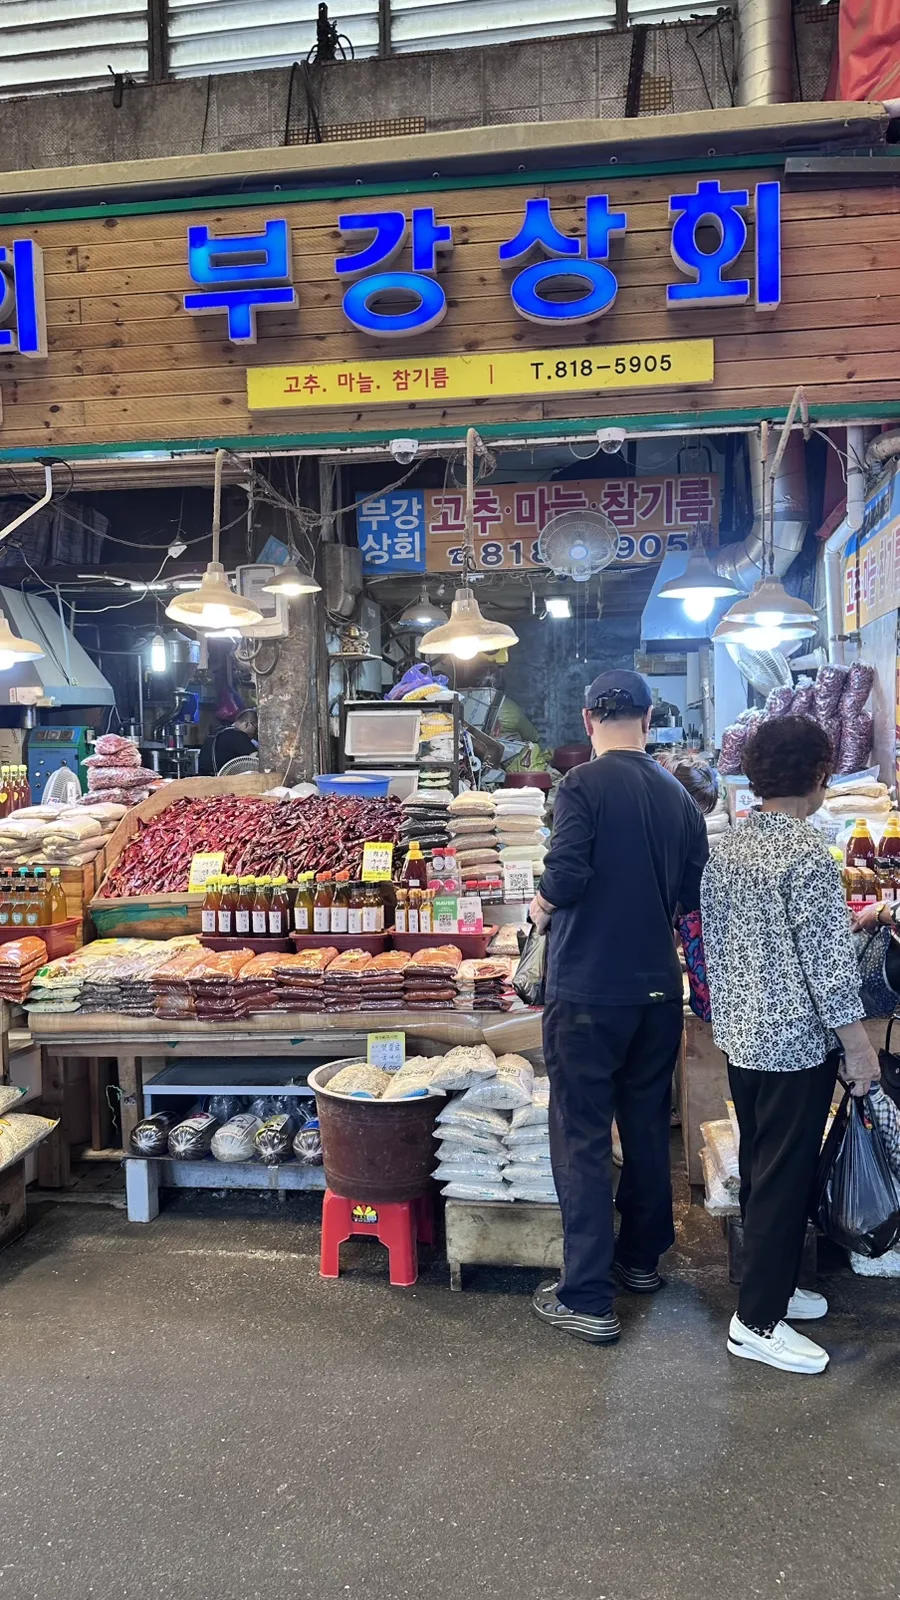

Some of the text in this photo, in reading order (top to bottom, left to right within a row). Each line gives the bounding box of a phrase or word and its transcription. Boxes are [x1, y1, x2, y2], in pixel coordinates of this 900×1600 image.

[184, 180, 782, 345] 부강상회
[392, 368, 449, 390] 참기름
[532, 355, 671, 379] T.818-5905
[360, 497, 421, 530] 부강
[360, 532, 421, 565] 상회
